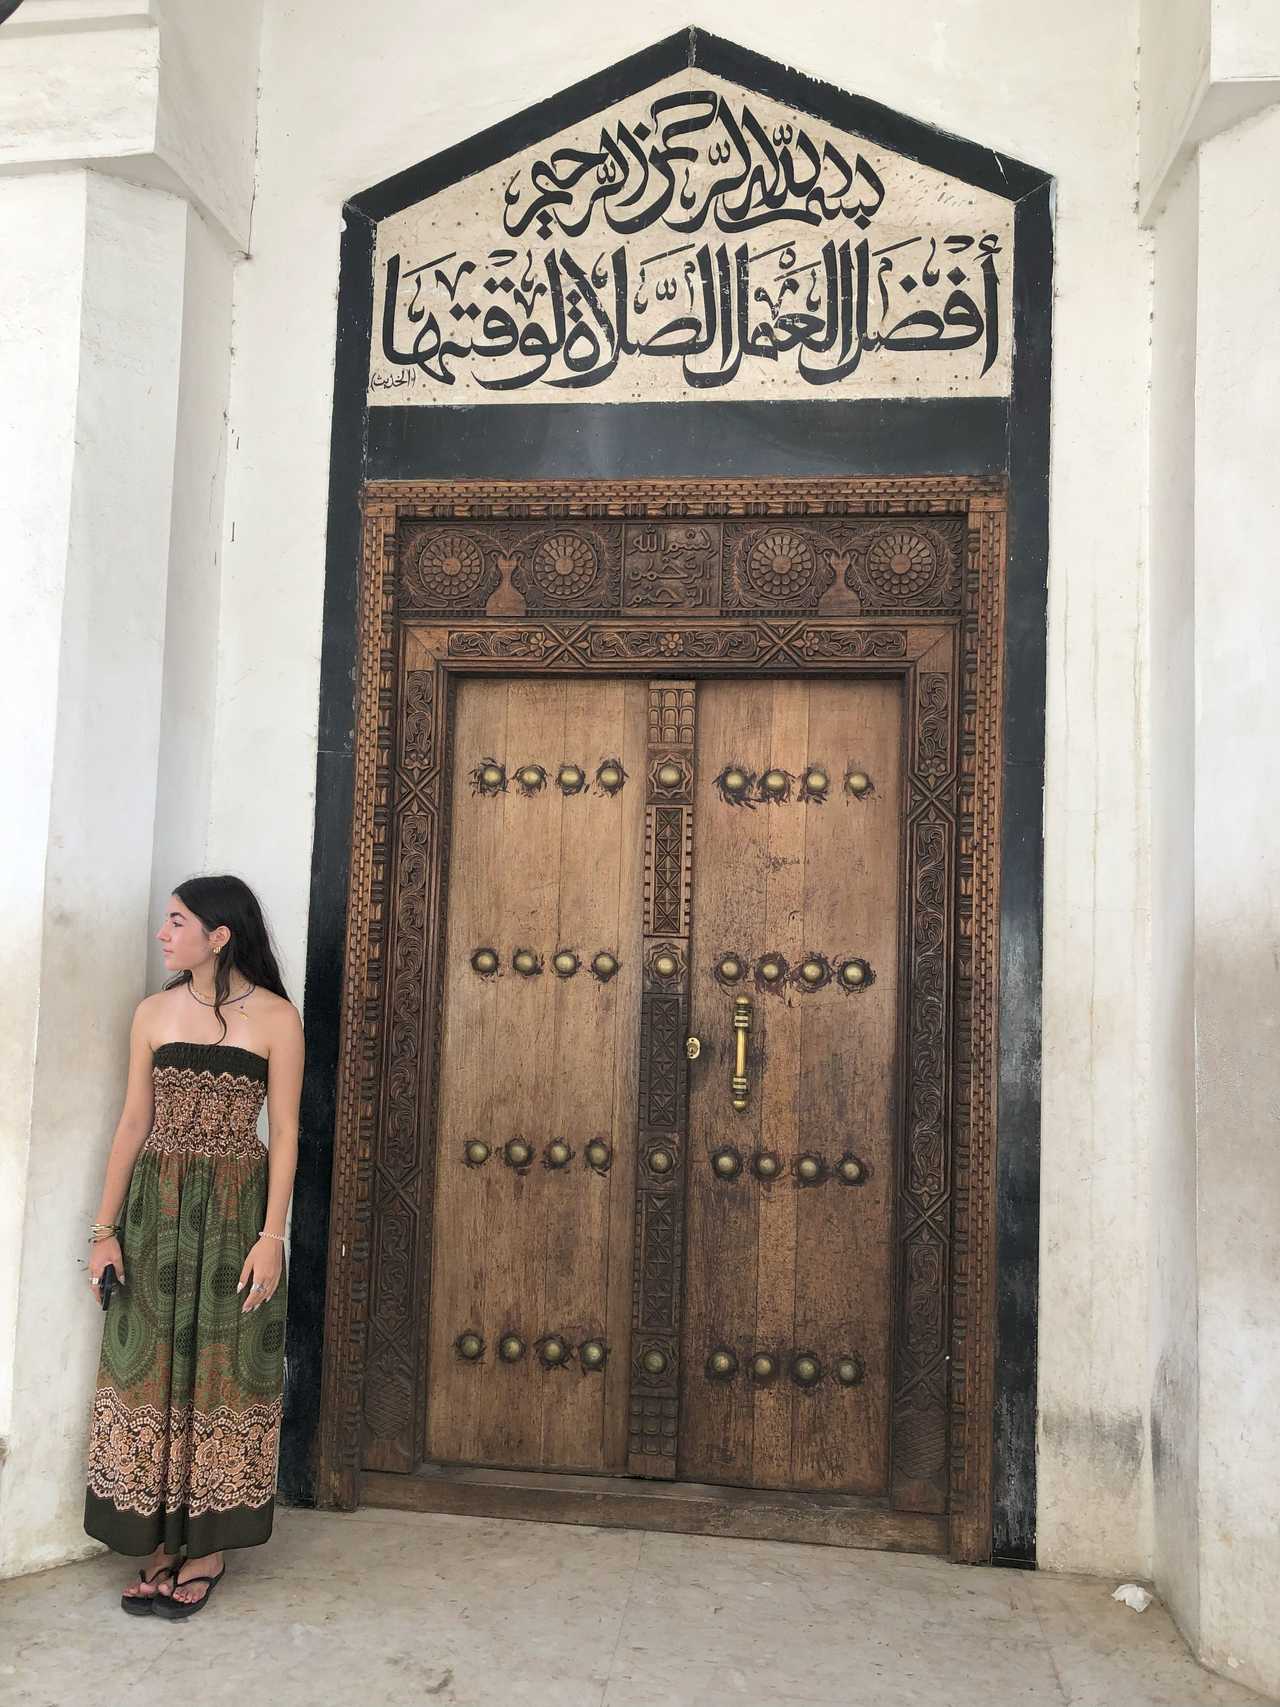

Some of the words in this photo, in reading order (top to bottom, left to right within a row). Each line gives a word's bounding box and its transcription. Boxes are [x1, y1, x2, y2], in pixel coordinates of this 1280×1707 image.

[503, 119, 649, 240] الرحيم
[604, 90, 779, 235] الرحمن
[714, 153, 886, 232] بسم
[724, 123, 852, 221] الله
[382, 248, 567, 391] لوقتها
[541, 243, 732, 389] الصلاة
[682, 239, 854, 389] العمل
[798, 233, 1003, 386] أفضل
